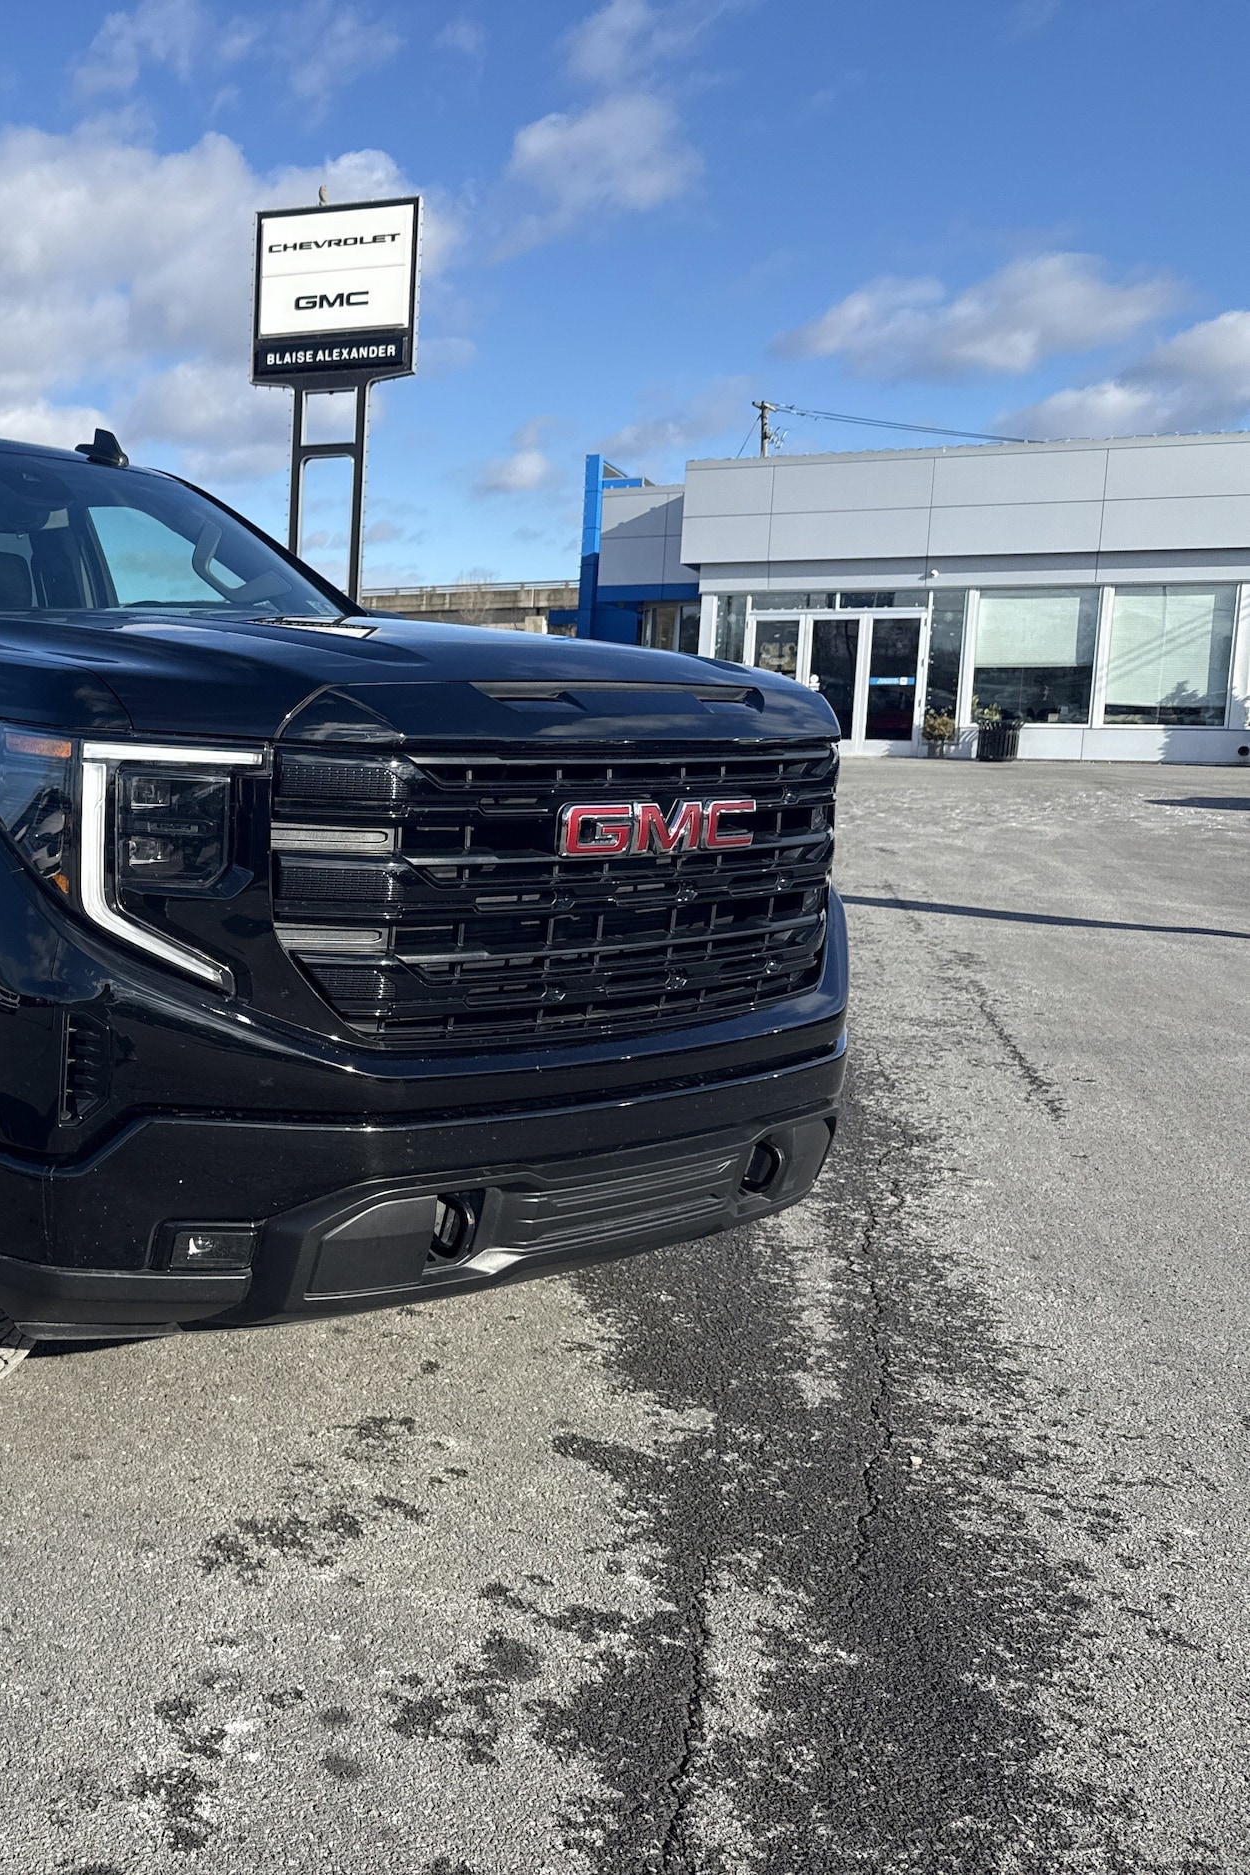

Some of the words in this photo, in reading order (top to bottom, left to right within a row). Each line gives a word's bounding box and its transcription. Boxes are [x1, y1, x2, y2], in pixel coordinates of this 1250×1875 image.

[268, 233, 401, 253] CHEVROLET
[294, 291, 369, 311] GMC
[266, 350, 314, 366] BLAISE
[315, 344, 396, 362] ALEXANDER
[556, 799, 757, 858] GMC
